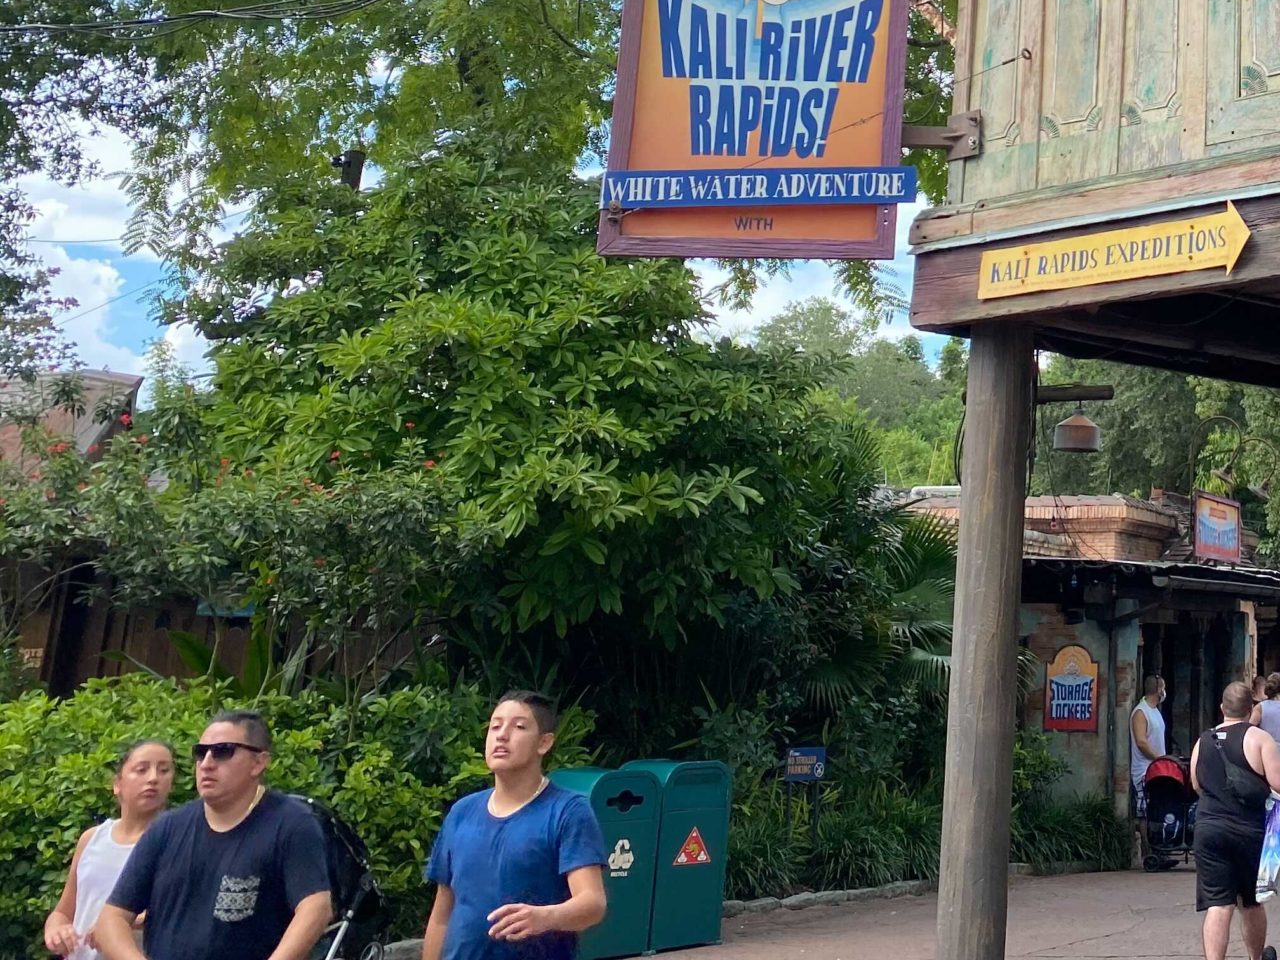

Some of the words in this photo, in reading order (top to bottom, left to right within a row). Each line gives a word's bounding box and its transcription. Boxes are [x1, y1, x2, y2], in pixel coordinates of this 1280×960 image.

[607, 176, 684, 202] WHITE
[688, 174, 768, 200] WATER
[774, 172, 905, 198] ADVENTURE
[734, 217, 774, 231] WITH
[990, 257, 1031, 284] KALI
[1037, 248, 1098, 275] RAPIDS
[1105, 225, 1227, 266] EXPEDITIONS
[1050, 679, 1094, 700] STORAGE
[1050, 702, 1092, 720] LOCKERS
